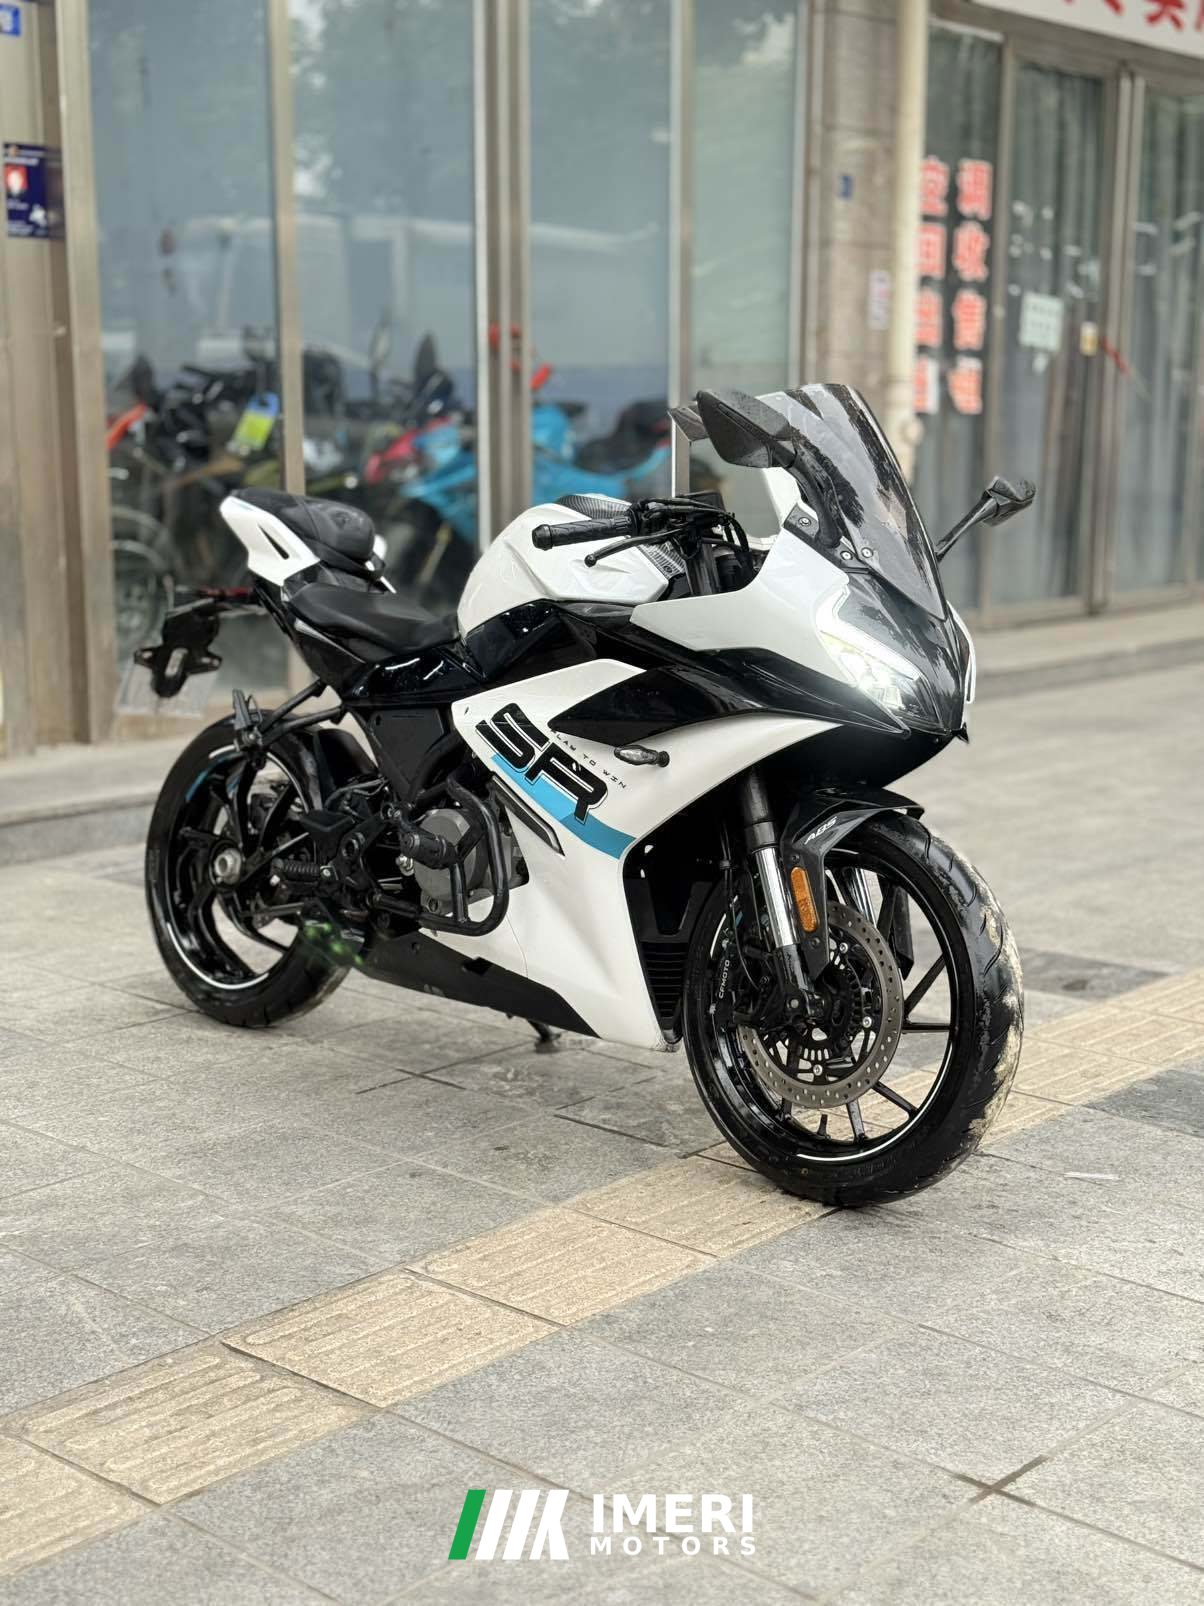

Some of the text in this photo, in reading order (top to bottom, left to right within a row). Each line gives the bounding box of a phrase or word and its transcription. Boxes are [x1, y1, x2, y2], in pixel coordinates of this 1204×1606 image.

[474, 702, 608, 825] SR
[583, 753, 597, 766] TO
[603, 769, 627, 789] WIN
[804, 816, 838, 845] ABS
[719, 959, 730, 999] CFMOTO
